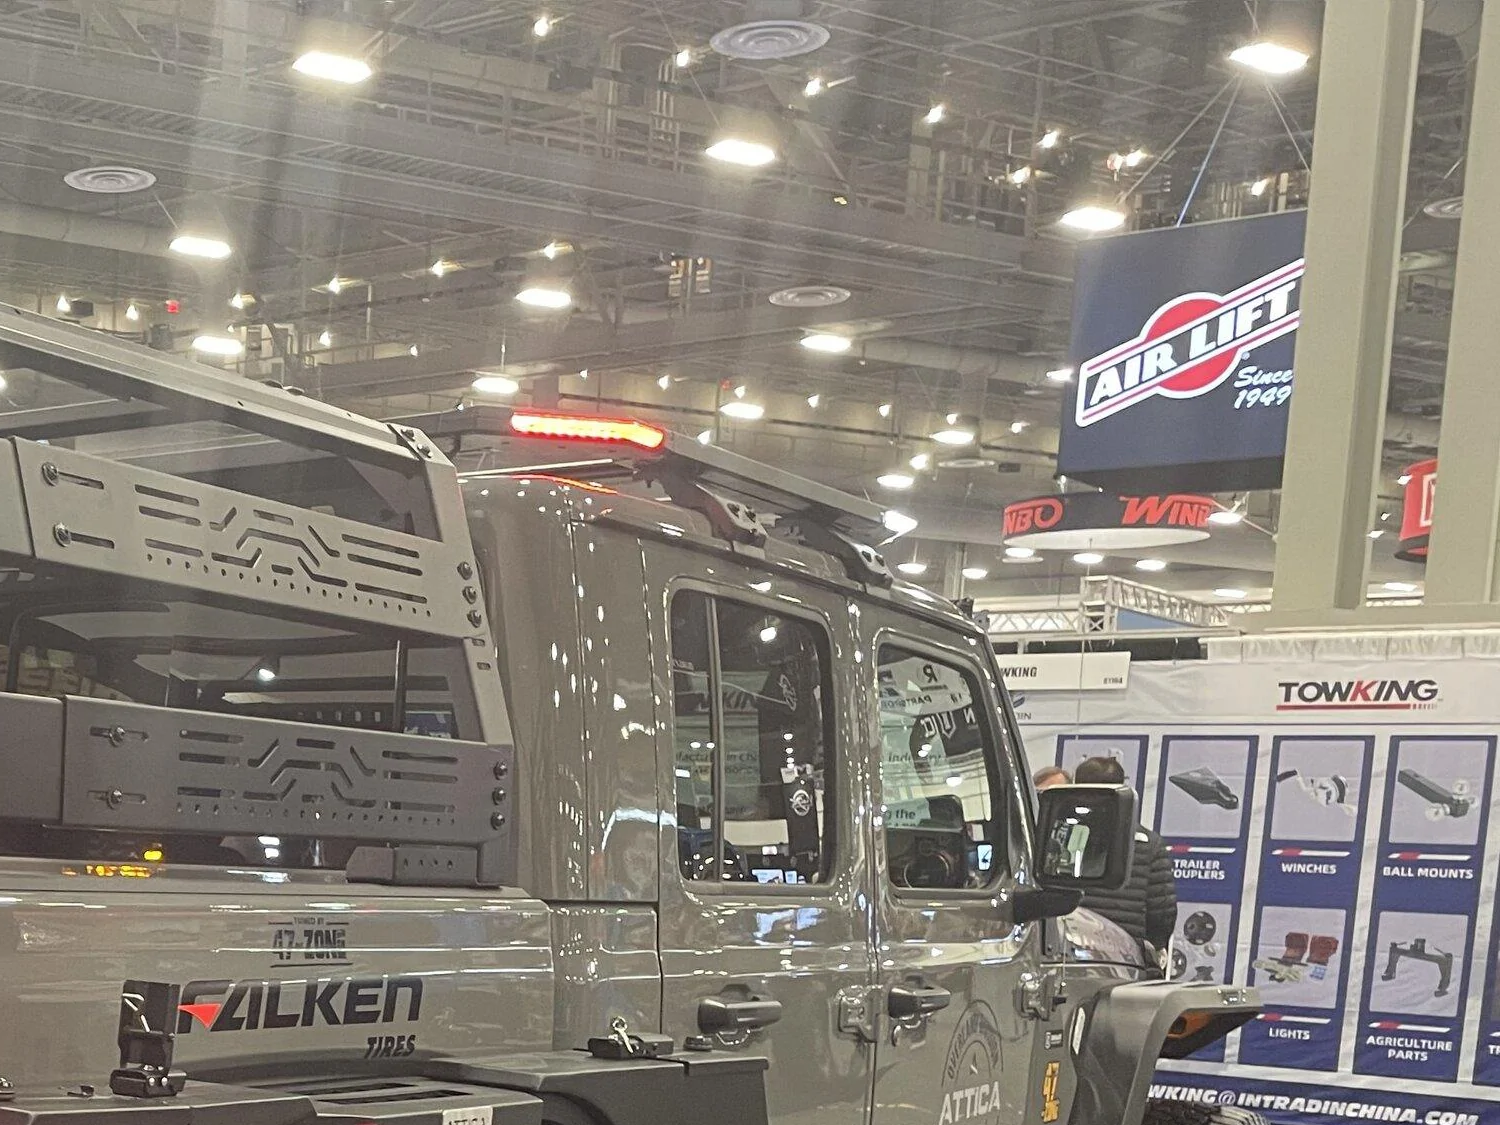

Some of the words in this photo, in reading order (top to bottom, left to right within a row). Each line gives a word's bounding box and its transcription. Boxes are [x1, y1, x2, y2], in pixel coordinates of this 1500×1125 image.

[1090, 343, 1177, 406] AIR
[1189, 281, 1297, 359] LIFT
[1234, 366, 1293, 388] Since
[1234, 386, 1292, 409] 1949
[1278, 680, 1438, 703] TOWKING
[1174, 859, 1220, 870] TRAILER
[1281, 863, 1336, 875] WINCHES
[1171, 869, 1225, 880] OUPLERS
[1383, 866, 1414, 878] BALL
[1417, 867, 1474, 880] MOUNTS
[177, 976, 424, 1034] FALKEN
[1269, 1027, 1310, 1040] LIGHTS
[365, 1034, 416, 1059] TIRES
[1366, 1035, 1453, 1051] AGRICULTURE
[1387, 1049, 1428, 1062] PARTS
